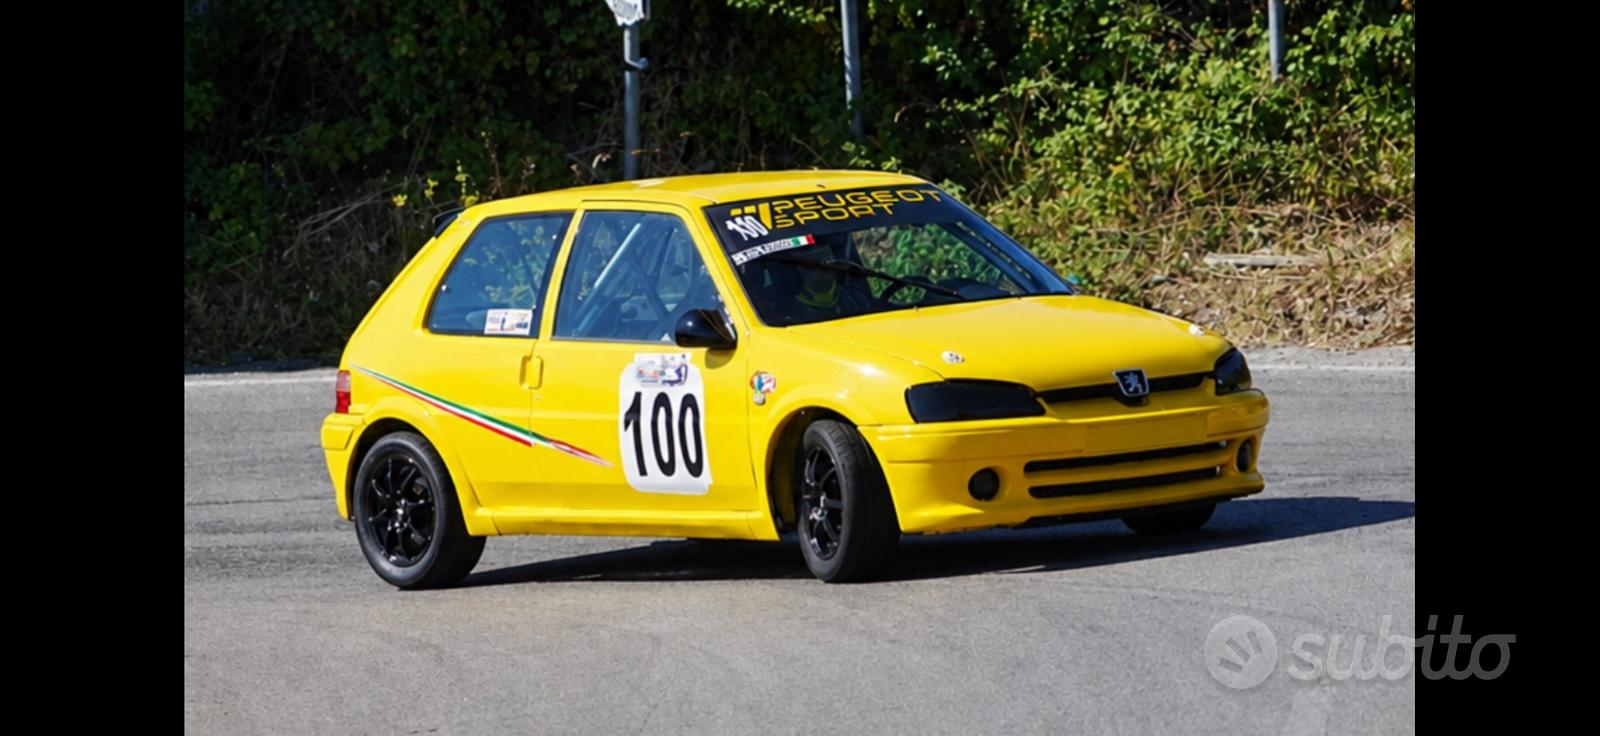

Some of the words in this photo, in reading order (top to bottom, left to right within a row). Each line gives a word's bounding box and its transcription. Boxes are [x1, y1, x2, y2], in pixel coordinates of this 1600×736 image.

[771, 188, 941, 214] PEUGEOT
[725, 215, 769, 241] 100
[774, 203, 895, 229] SPORT
[624, 391, 704, 479] 100
